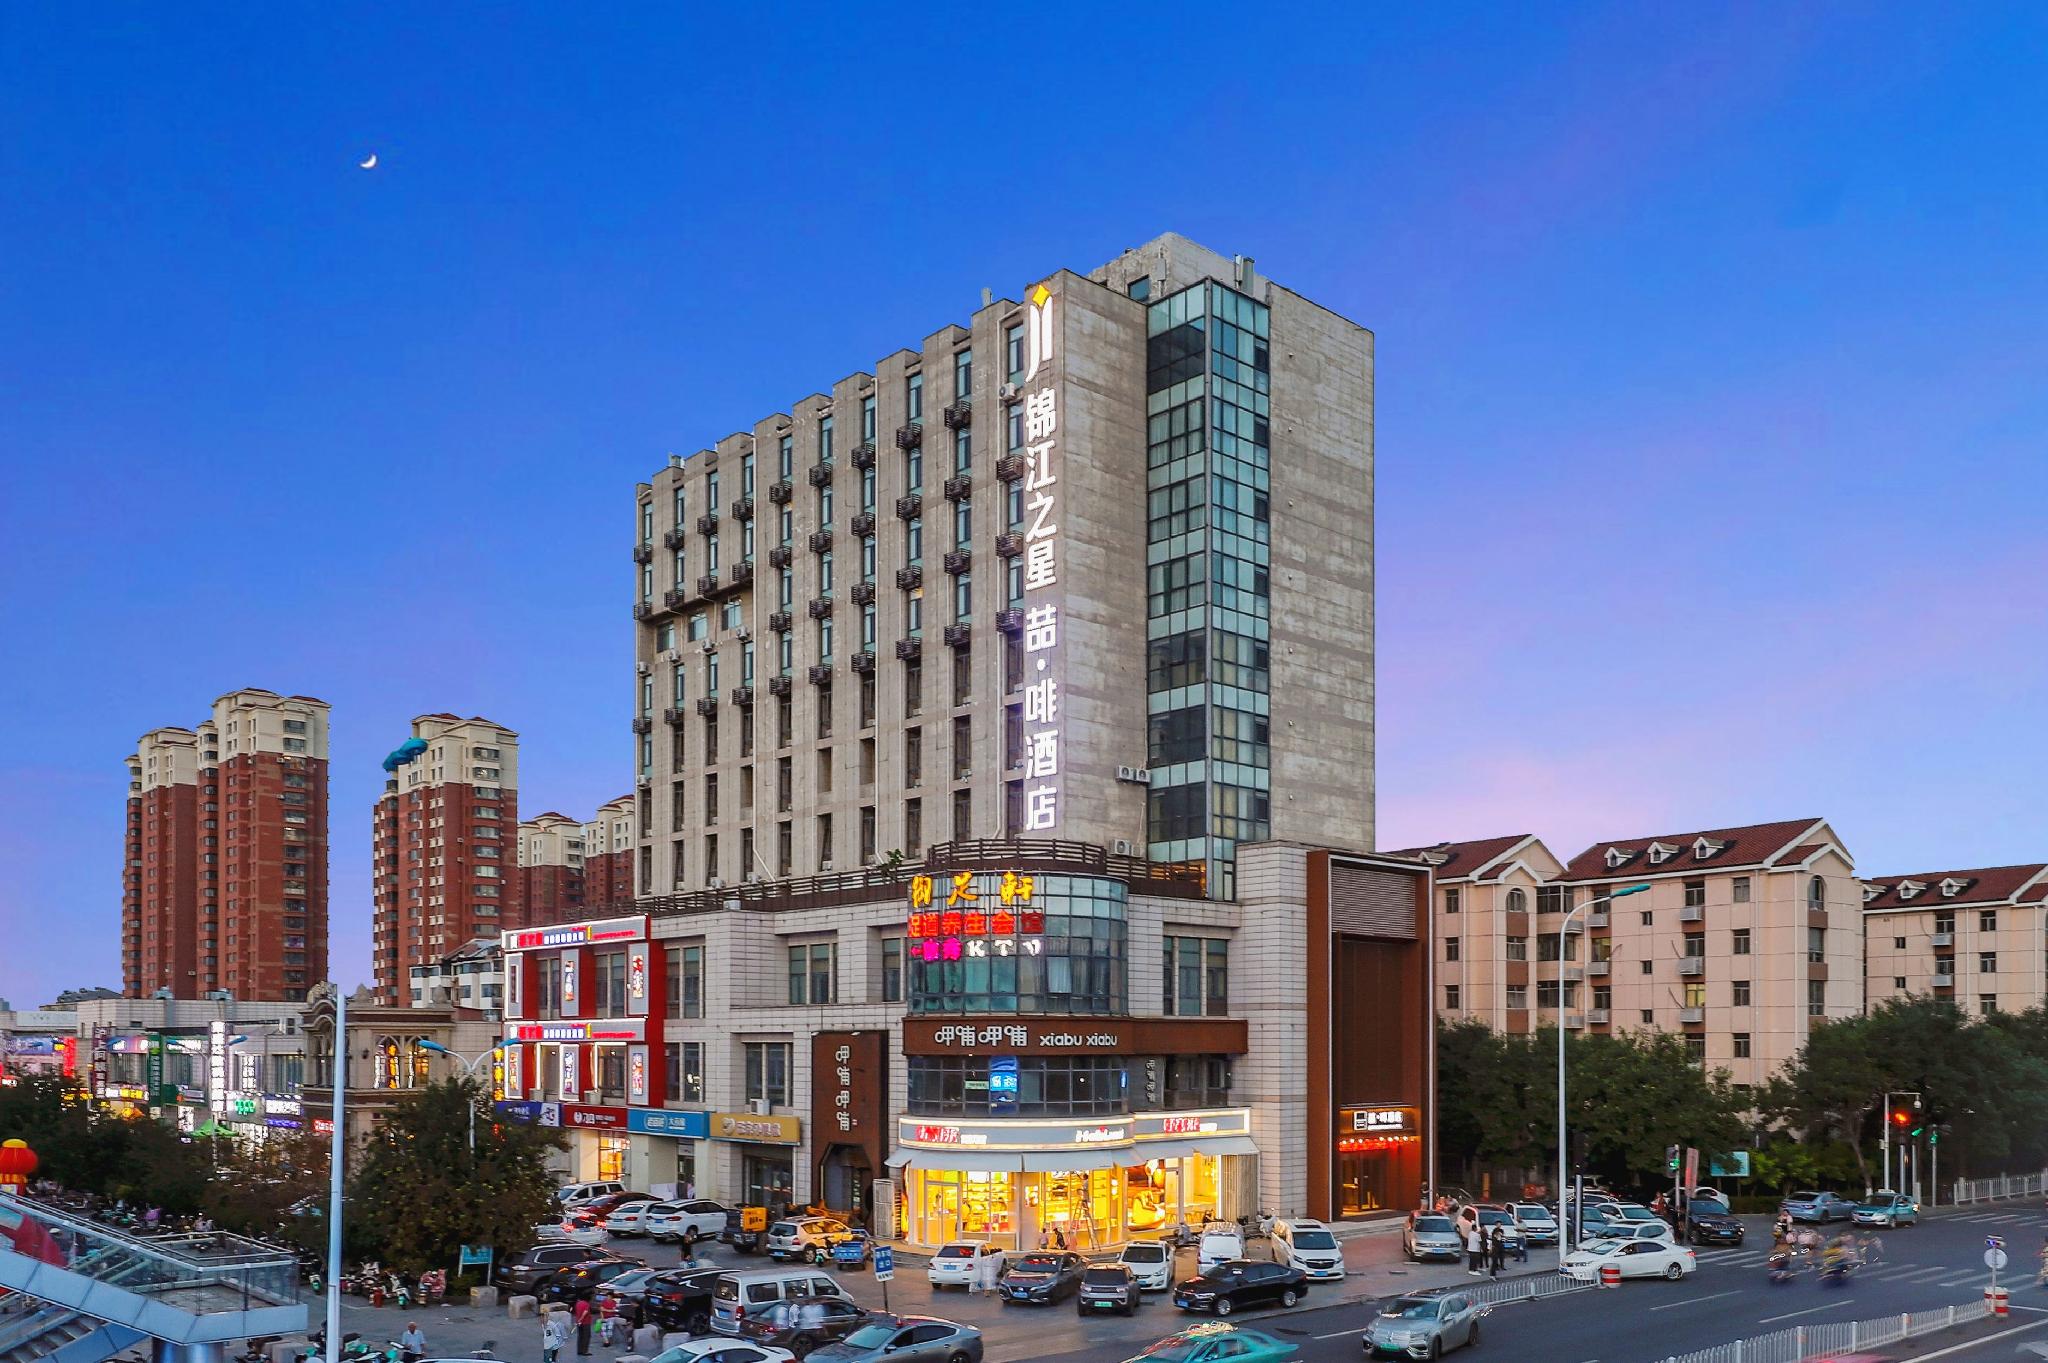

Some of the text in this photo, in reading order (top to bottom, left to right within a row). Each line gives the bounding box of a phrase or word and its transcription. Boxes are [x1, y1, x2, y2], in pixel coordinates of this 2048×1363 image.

[1025, 387, 1058, 591] 锦江之星
[934, 1025, 1117, 1047] 呷哺呷哺 xiabu xiabu
[835, 1045, 850, 1131] 呷哺呷哺
